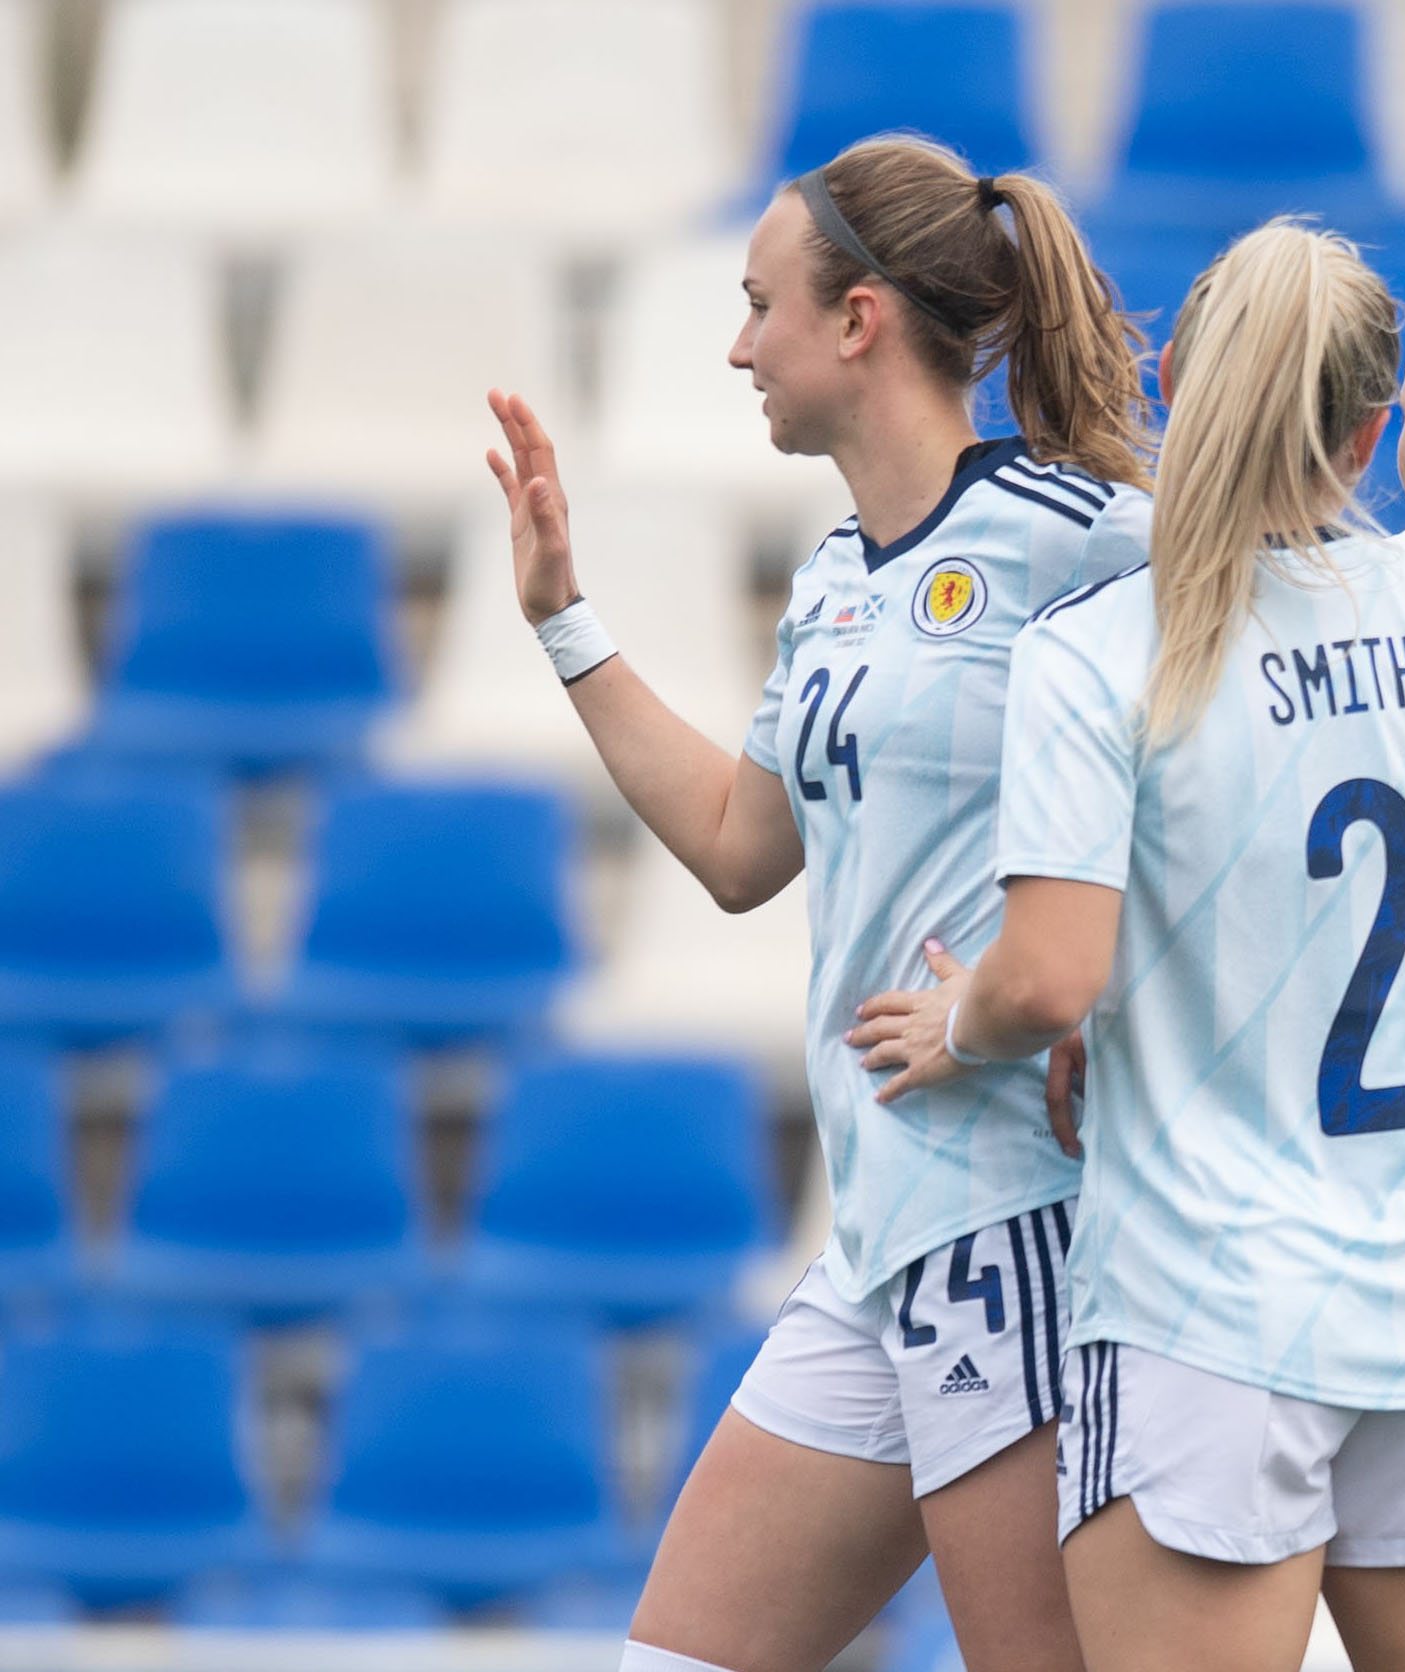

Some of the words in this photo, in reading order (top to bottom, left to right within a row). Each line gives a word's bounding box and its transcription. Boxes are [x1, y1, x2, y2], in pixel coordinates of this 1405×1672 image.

[796, 664, 869, 802] 24
[898, 1232, 1006, 1349] 24
[940, 1379, 989, 1395] adidas
